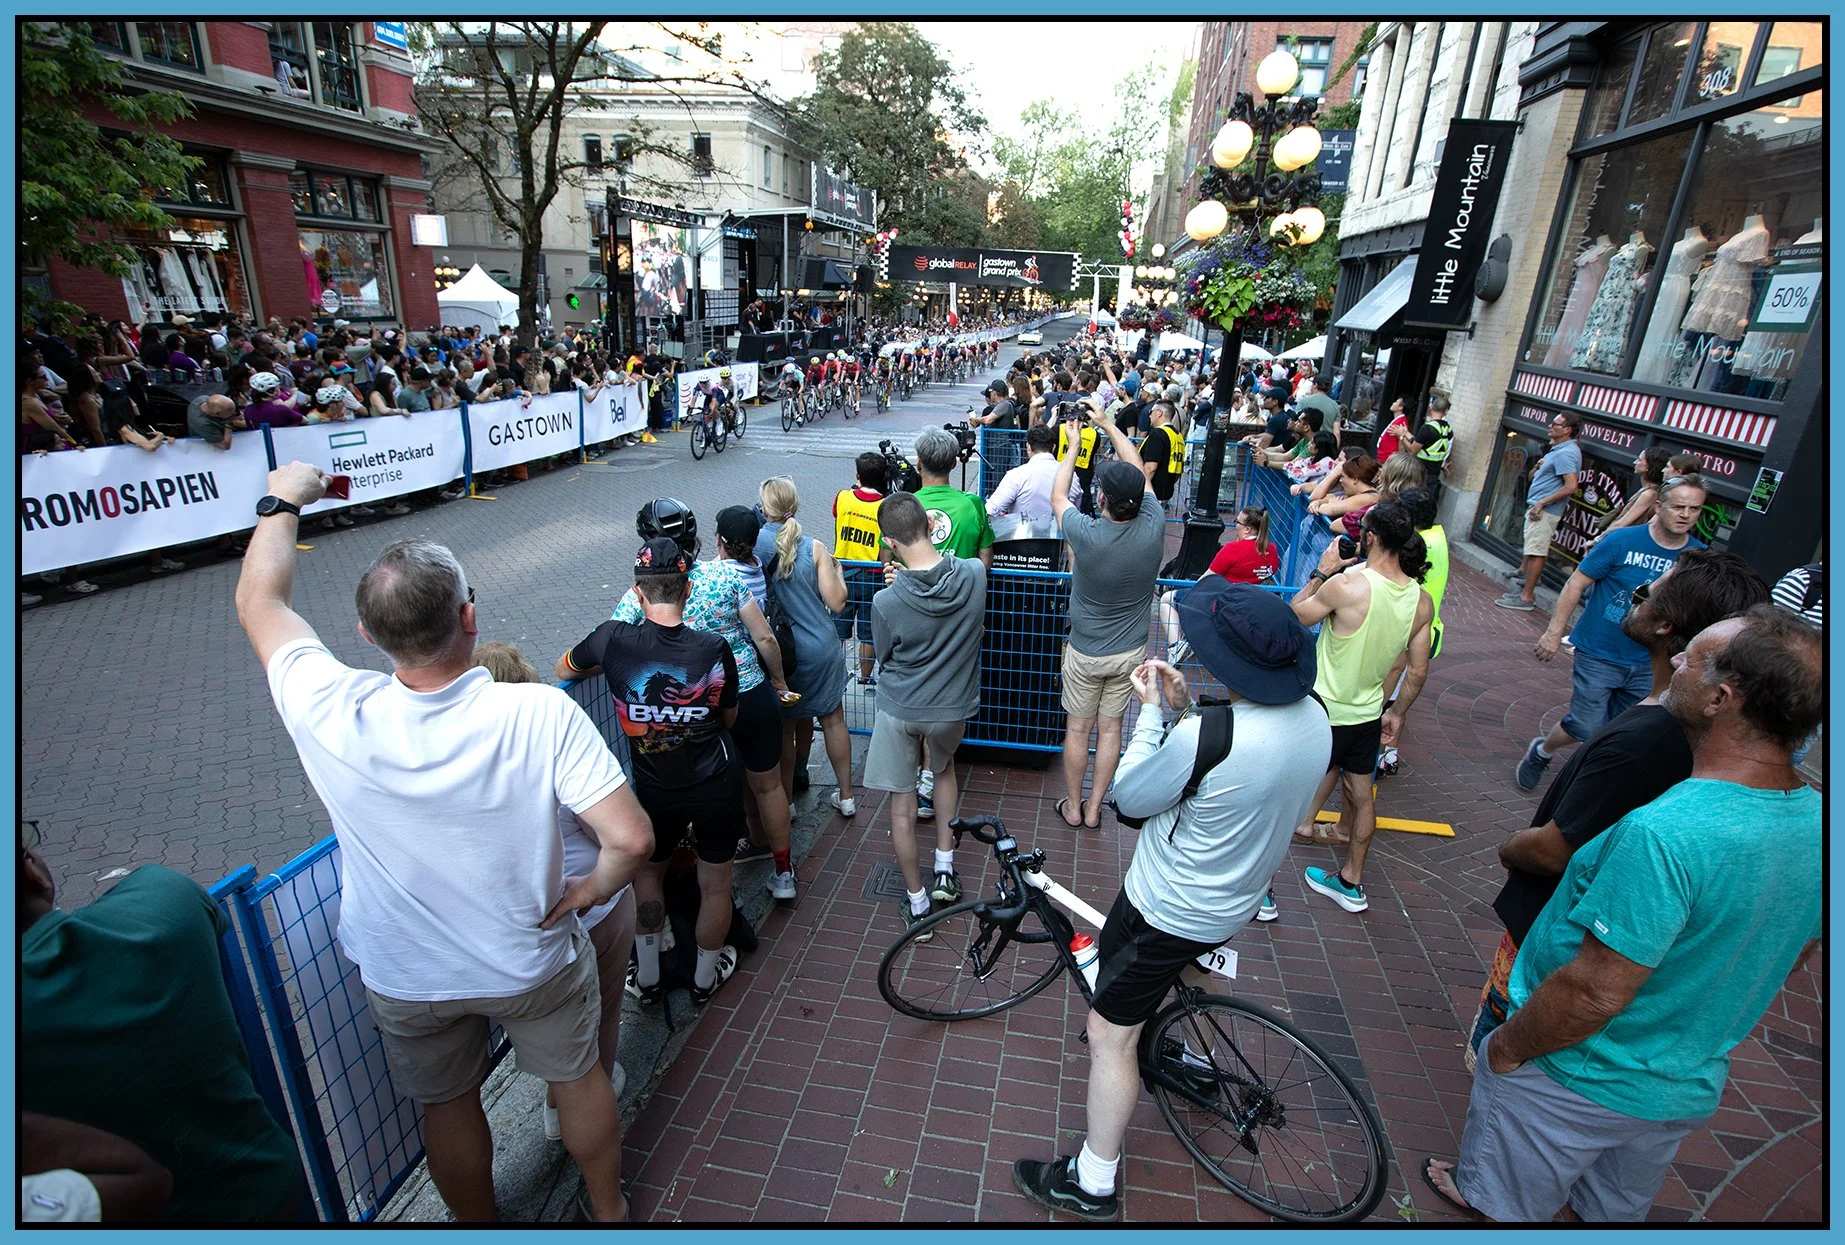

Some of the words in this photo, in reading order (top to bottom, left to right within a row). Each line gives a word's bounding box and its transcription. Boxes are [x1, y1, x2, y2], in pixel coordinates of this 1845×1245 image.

[1700, 66, 1732, 97] 308
[1429, 258, 1459, 304] little
[1444, 143, 1489, 250] Mountain
[982, 257, 1017, 268] gastown
[982, 266, 1006, 276] grand
[1006, 268, 1021, 278] prix
[1771, 286, 1810, 308] 50%
[609, 396, 627, 424] Bell
[488, 411, 573, 446] GASTOWN
[1581, 423, 1635, 448] NOVELTY
[332, 452, 387, 473] Hewlett
[388, 443, 434, 463] Packard
[349, 468, 403, 488] nterprise
[840, 525, 876, 548] MEDIA
[1009, 554, 1017, 562] in
[1028, 556, 1050, 564] place!
[1623, 550, 1678, 573] AMSTER
[628, 703, 710, 723] BWR
[1208, 951, 1226, 971] 79
